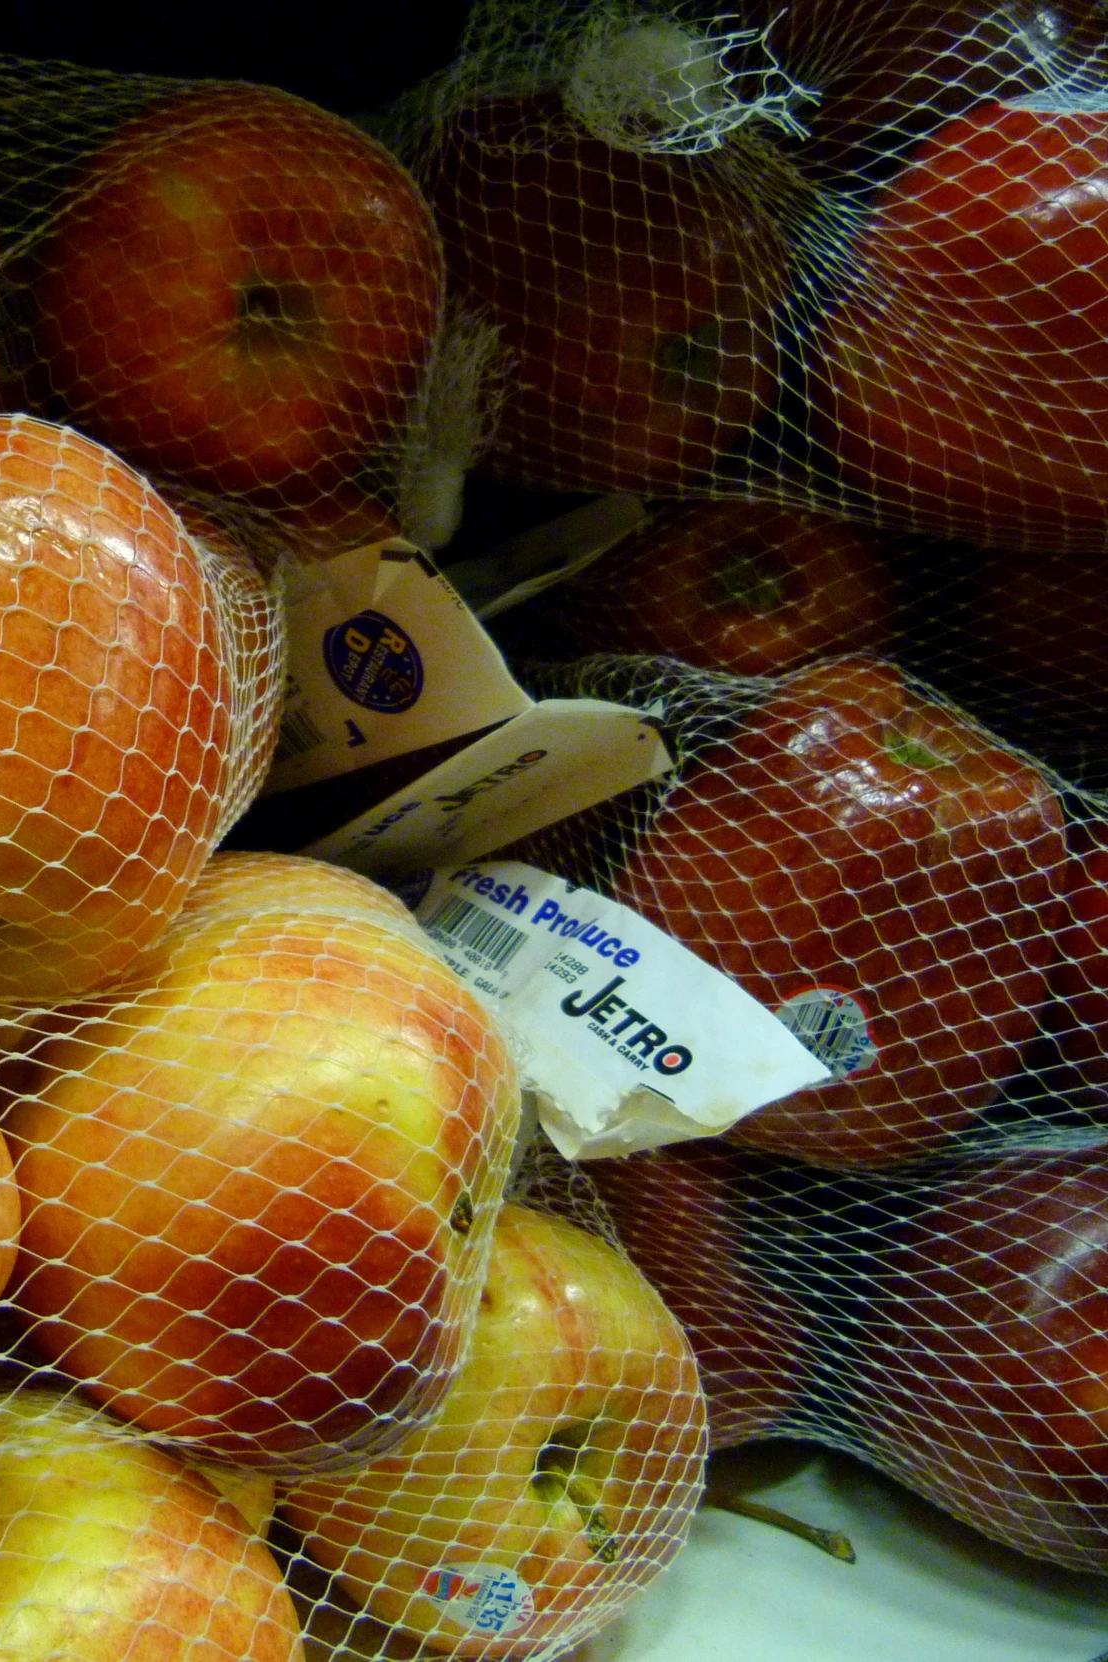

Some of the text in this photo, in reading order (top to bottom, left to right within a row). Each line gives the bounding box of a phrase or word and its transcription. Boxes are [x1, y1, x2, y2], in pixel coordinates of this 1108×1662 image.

[530, 898, 641, 968] Produce
[473, 976, 499, 996] GALA
[542, 961, 578, 985] 14293
[552, 951, 590, 976] 14288
[560, 975, 693, 1075] JETRO
[587, 1022, 651, 1071] CASH & CARRY
[475, 1571, 516, 1632] 4135
